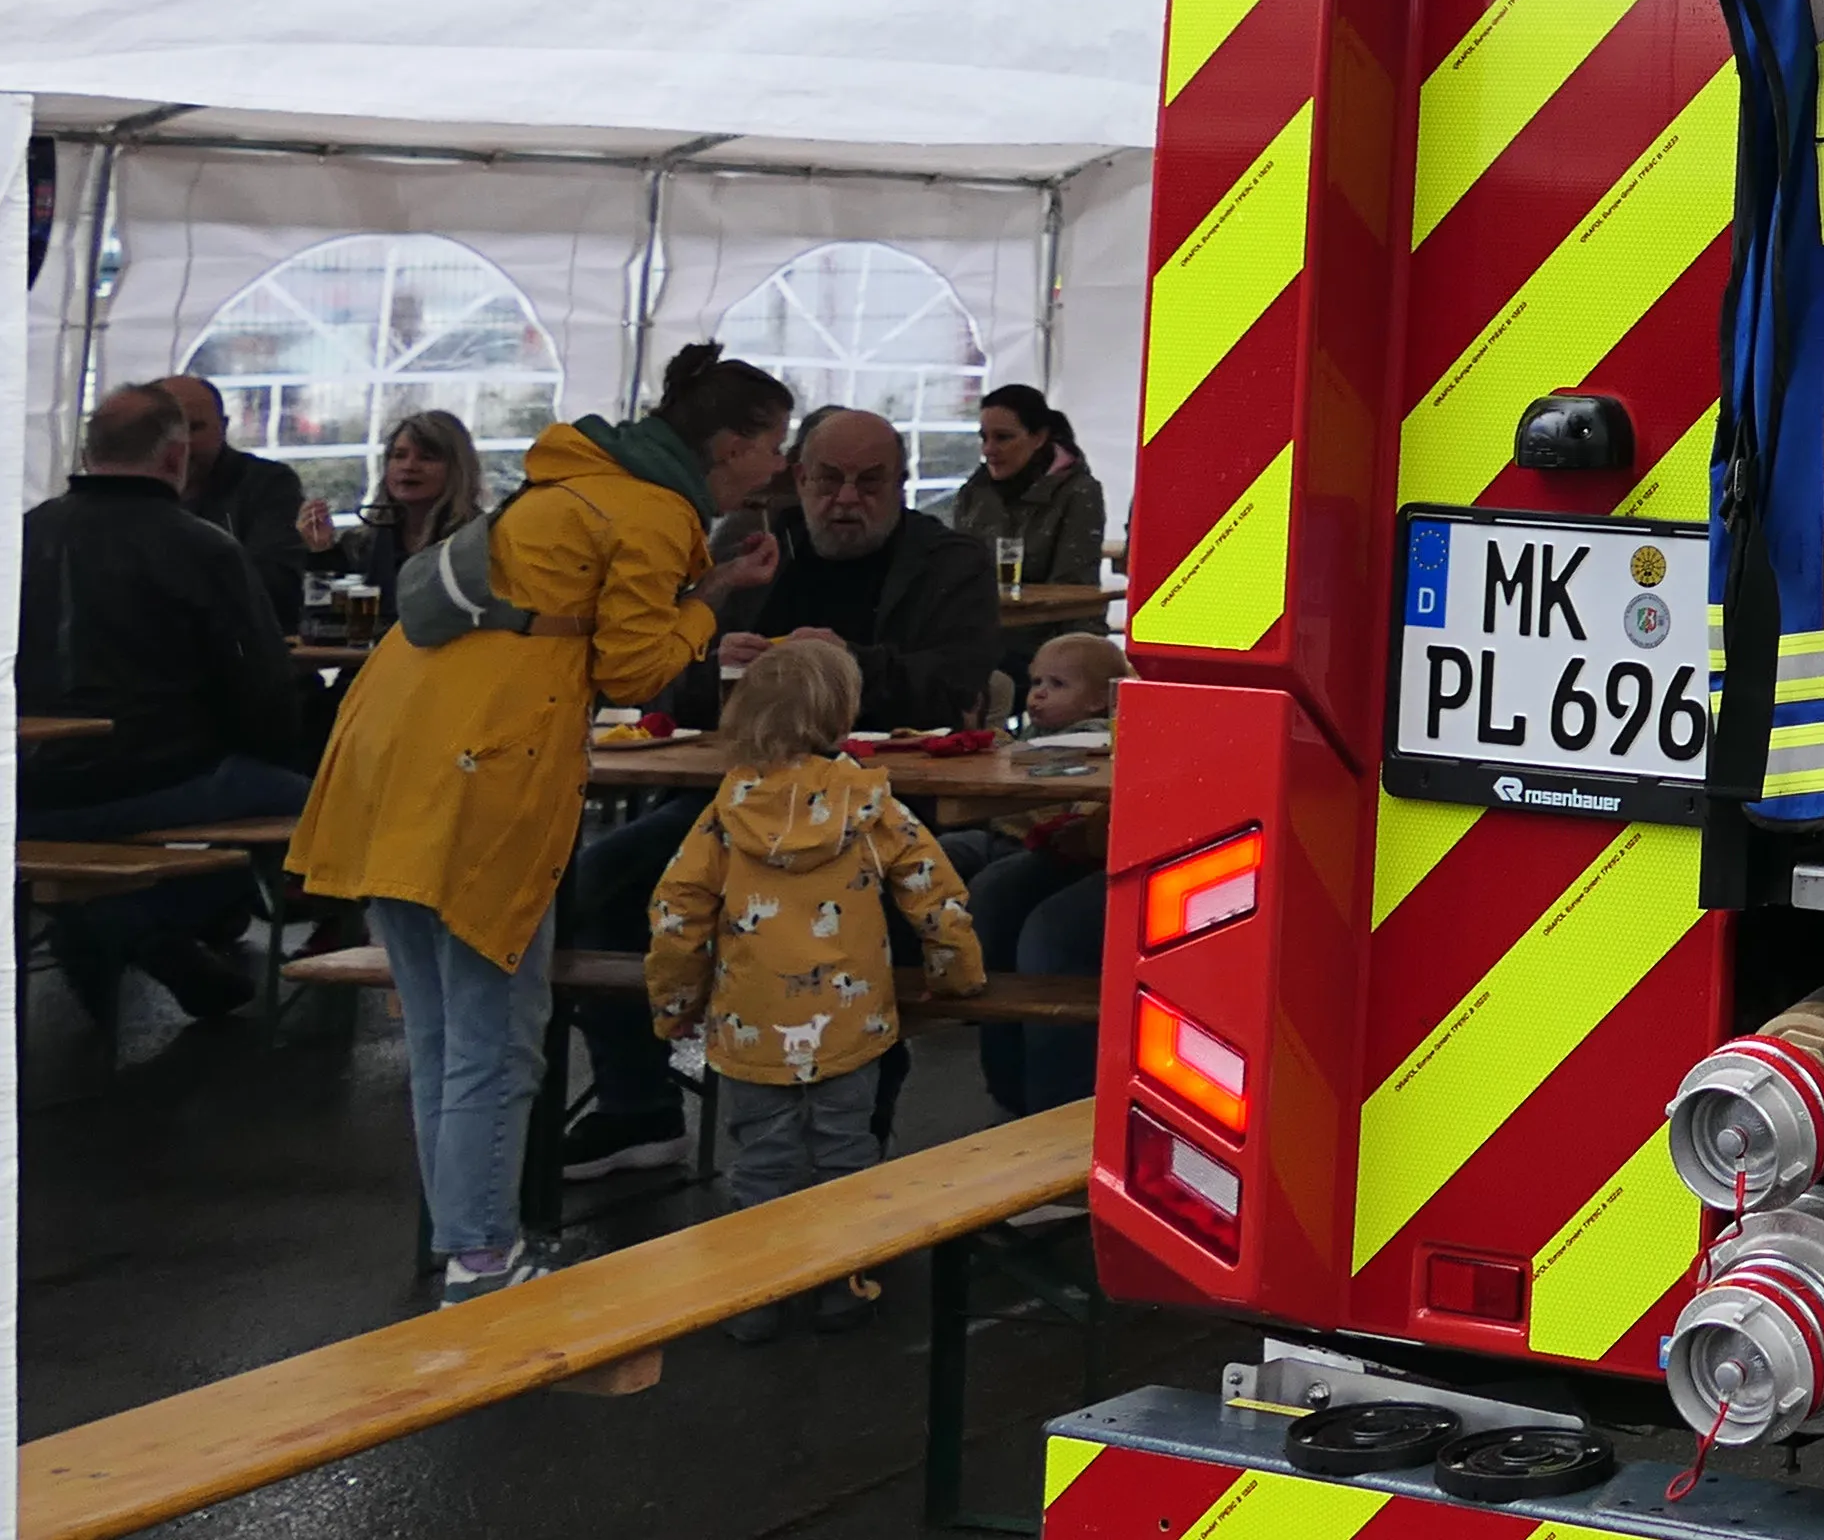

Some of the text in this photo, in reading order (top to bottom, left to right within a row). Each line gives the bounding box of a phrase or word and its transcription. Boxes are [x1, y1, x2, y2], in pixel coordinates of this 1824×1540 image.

[1418, 585, 1436, 614] D
[1484, 539, 1590, 641] MK
[1426, 644, 1706, 763] PL 696
[1525, 784, 1621, 813] rosenbauer
